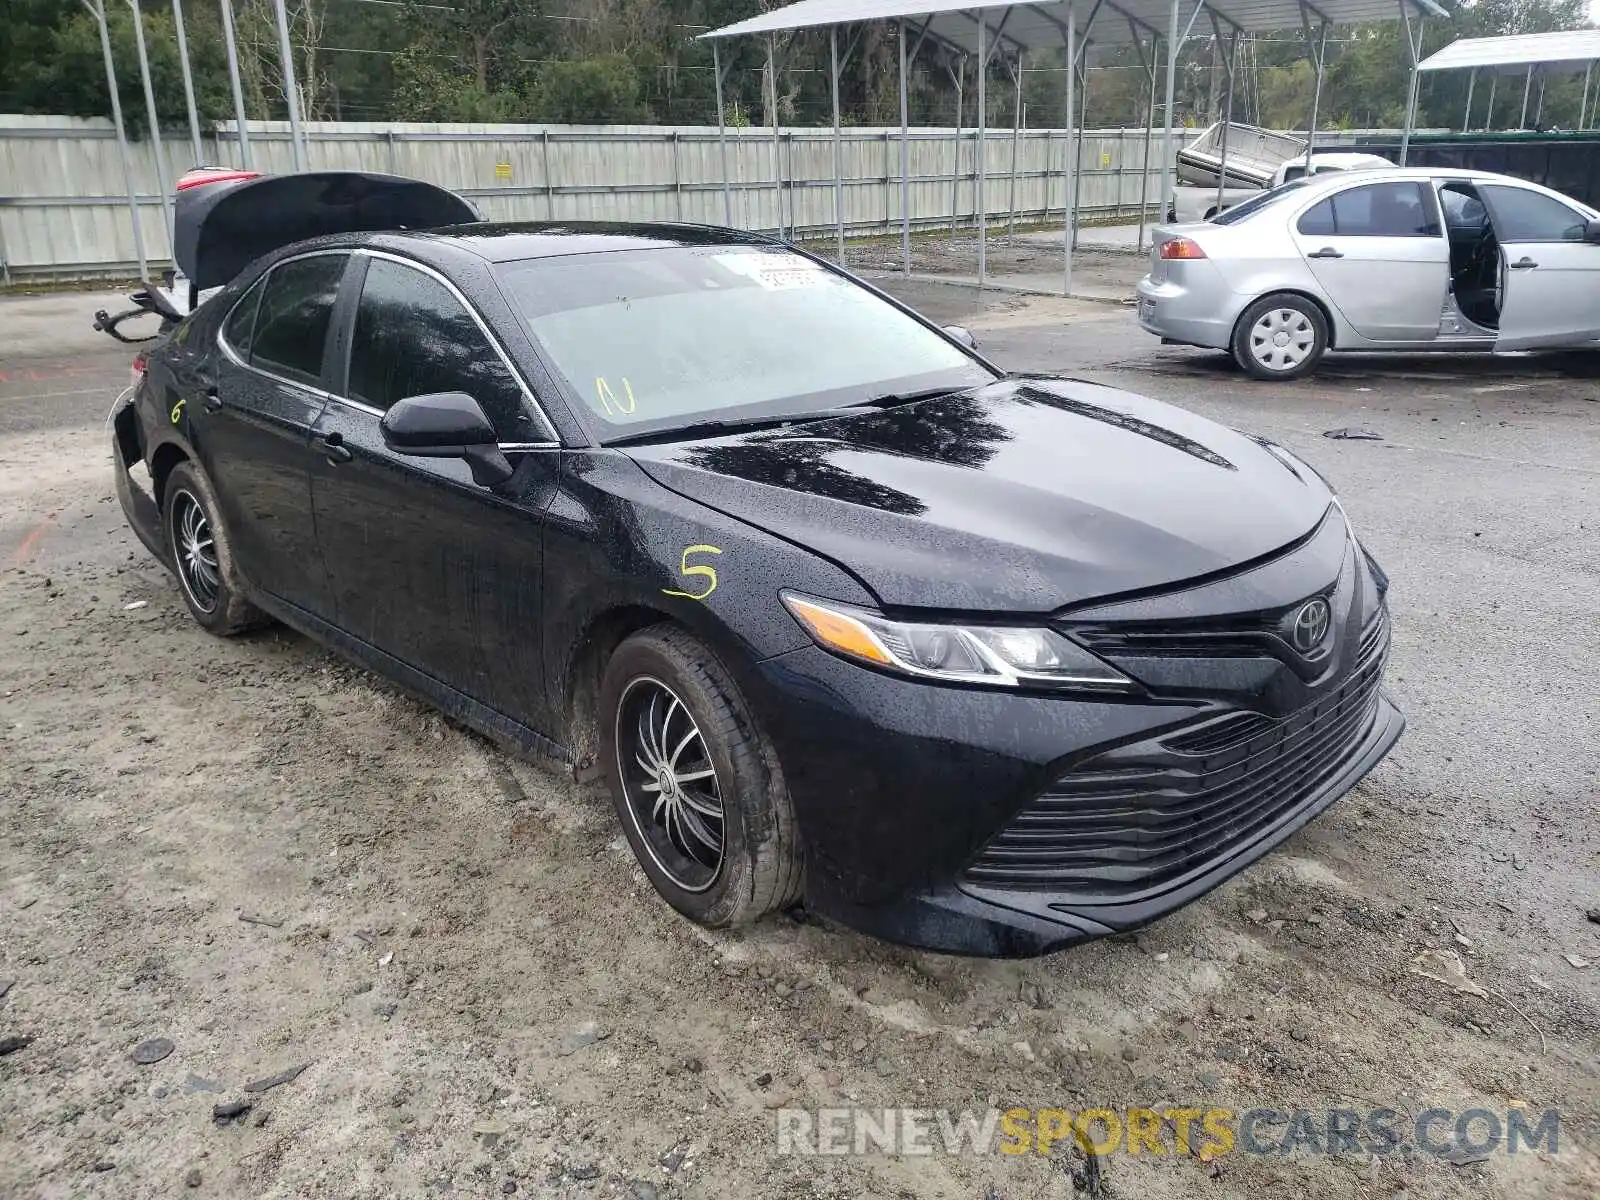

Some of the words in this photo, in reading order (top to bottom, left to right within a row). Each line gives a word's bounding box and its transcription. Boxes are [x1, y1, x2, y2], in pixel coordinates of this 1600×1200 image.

[171, 399, 186, 423] 6
[596, 377, 635, 416] N
[661, 544, 722, 599] 5
